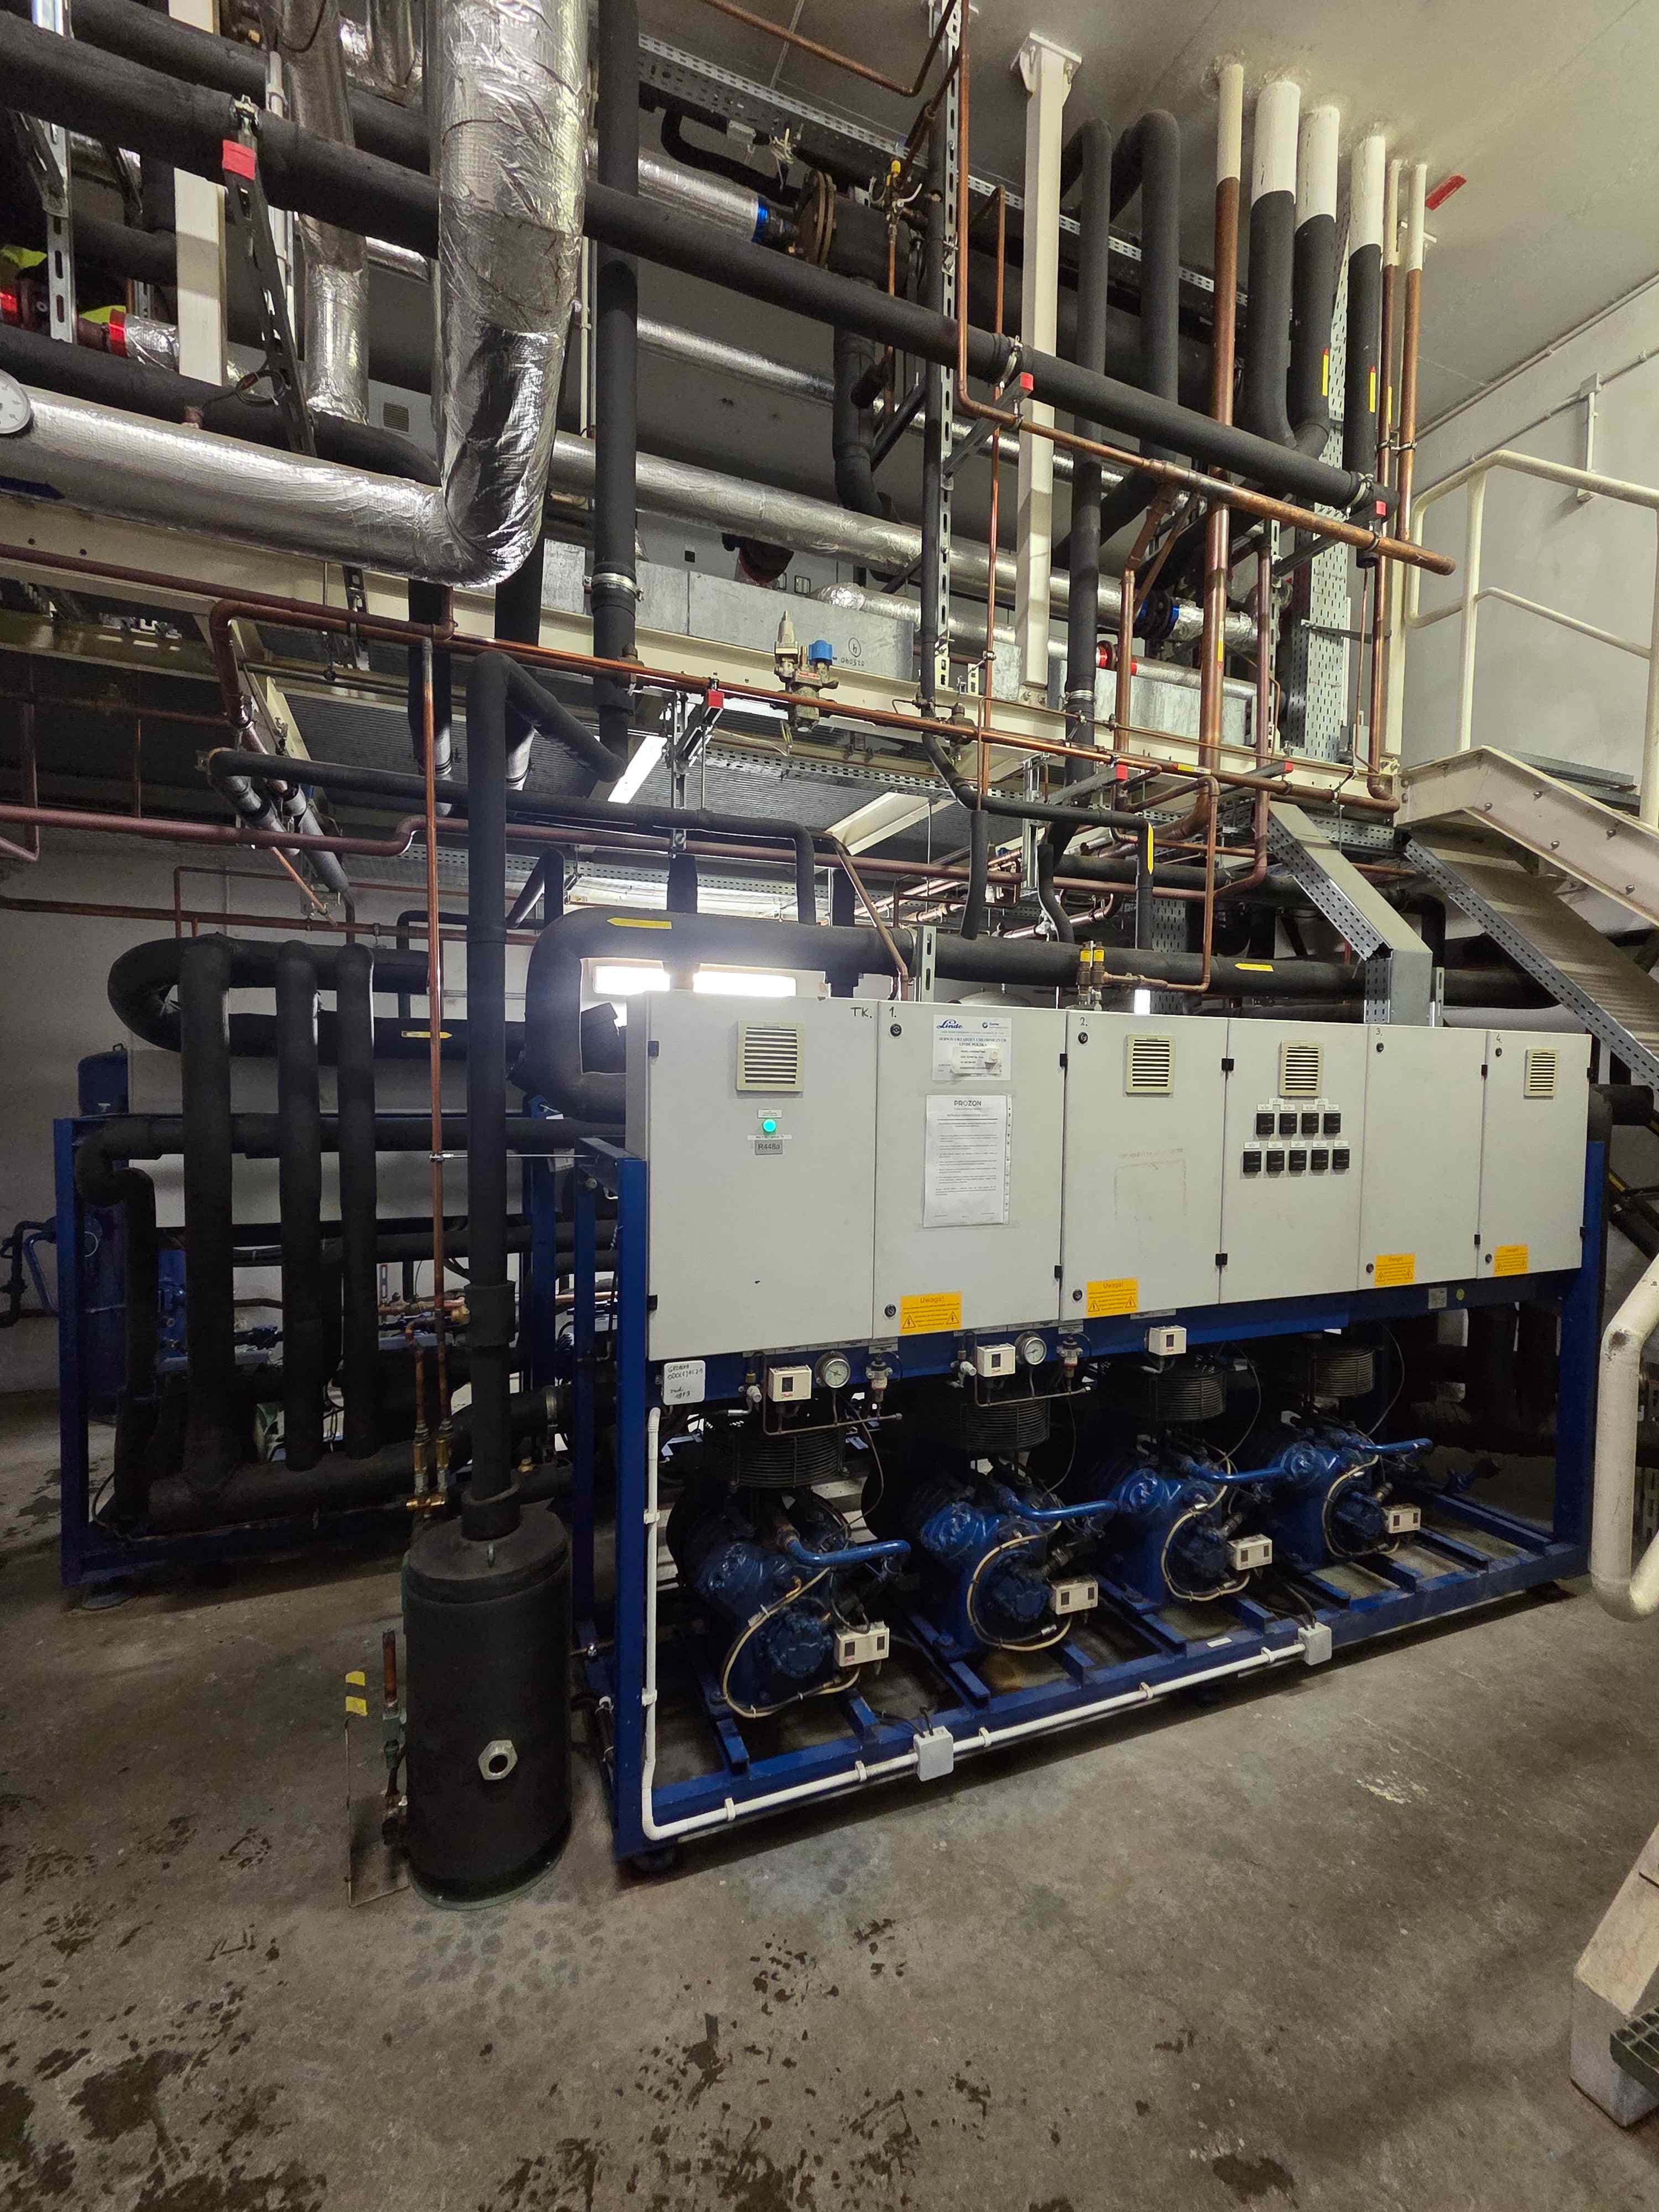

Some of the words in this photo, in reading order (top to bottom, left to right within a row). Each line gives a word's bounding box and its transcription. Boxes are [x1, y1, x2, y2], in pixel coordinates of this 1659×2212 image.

[850, 1006, 873, 1019] TK.
[889, 1006, 897, 1018] 1.
[936, 1019, 963, 1029] Linde
[1080, 1016, 1088, 1026] 2.
[1375, 1027, 1383, 1036] 3.
